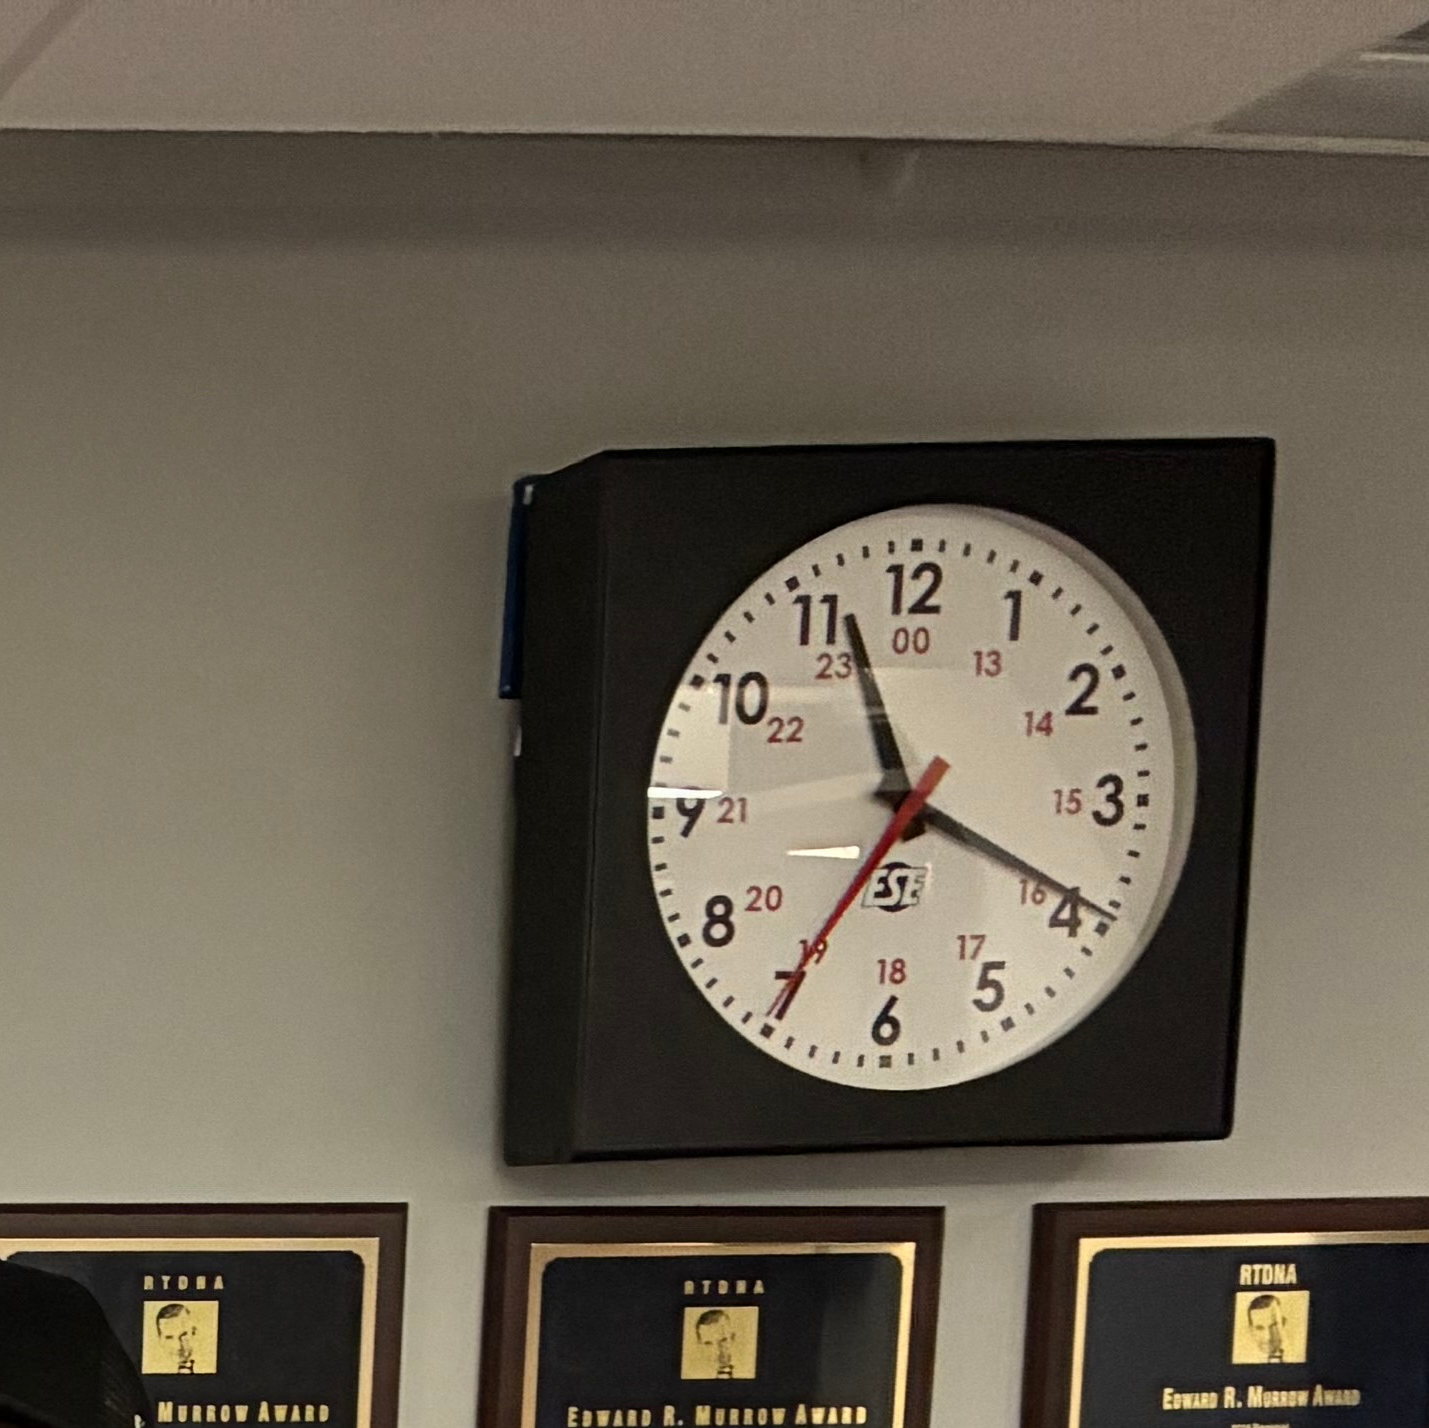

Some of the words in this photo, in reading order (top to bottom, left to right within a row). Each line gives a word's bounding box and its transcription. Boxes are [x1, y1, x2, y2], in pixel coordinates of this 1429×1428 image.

[886, 563, 942, 617] 12
[793, 596, 839, 645] 11
[1005, 590, 1022, 641] 1
[892, 628, 929, 655] 00
[815, 653, 852, 681] 23
[974, 651, 1003, 677] 13
[714, 672, 770, 725] 10
[1065, 663, 1099, 715] 2
[766, 717, 804, 744] 22
[1025, 711, 1054, 738] 14
[676, 787, 705, 838] 9
[717, 797, 749, 824] 21
[1053, 789, 1082, 815] 15
[1092, 775, 1125, 826] 3
[745, 885, 783, 912] 20
[1020, 879, 1047, 906] 16
[702, 894, 735, 948] 8
[1049, 888, 1082, 938] 4
[799, 938, 828, 965] 19
[957, 935, 986, 961] 17
[877, 958, 906, 985] 18
[774, 971, 806, 1020] 7
[973, 961, 1007, 1012] 5
[871, 995, 901, 1046] 6
[143, 1275, 224, 1290] RTDNA
[684, 1279, 765, 1296] RTDNA
[1239, 1264, 1297, 1285] RTDNA
[1162, 1388, 1218, 1410] EDWARD
[1223, 1386, 1242, 1408] R.
[1247, 1385, 1308, 1408] MURROW
[1312, 1384, 1361, 1407] AWARD
[157, 1401, 249, 1423] MURROW
[258, 1401, 330, 1422] AWARD
[567, 1406, 652, 1428] EDWARD
[663, 1405, 684, 1427] R.
[695, 1404, 786, 1427] MURROW
[794, 1404, 868, 1426] AWARD
